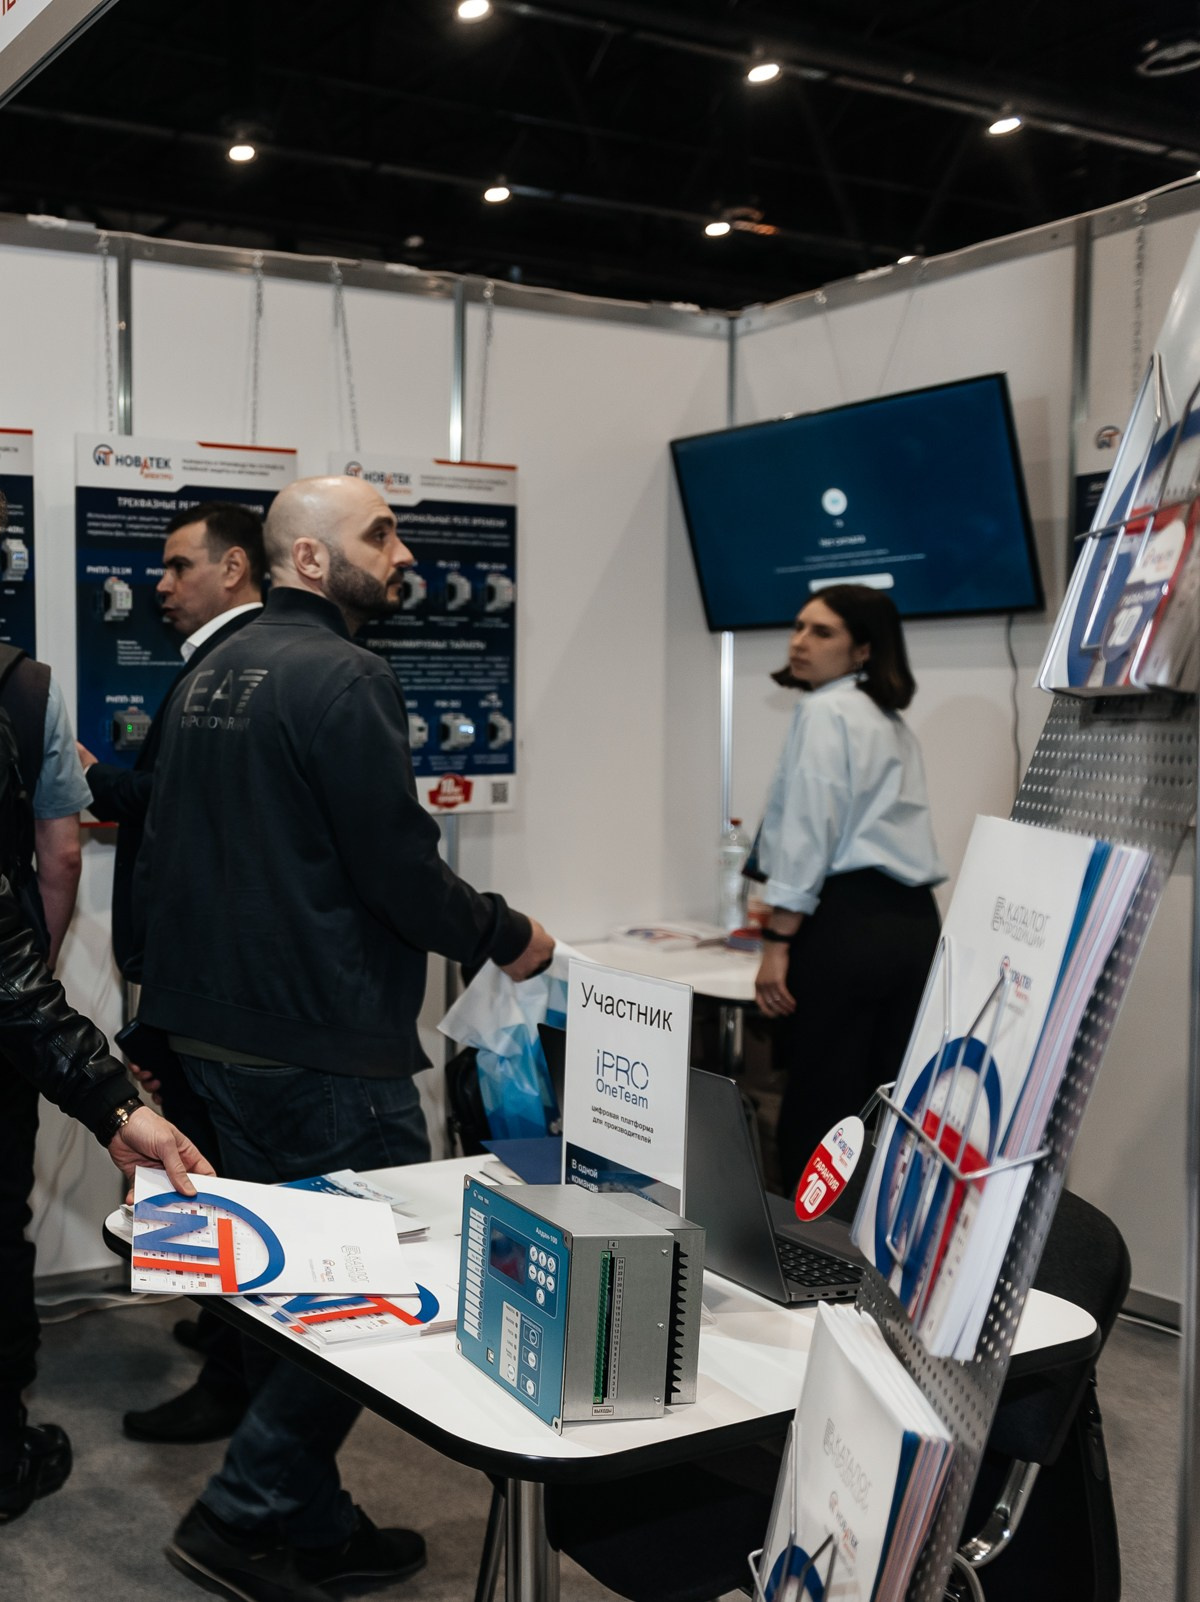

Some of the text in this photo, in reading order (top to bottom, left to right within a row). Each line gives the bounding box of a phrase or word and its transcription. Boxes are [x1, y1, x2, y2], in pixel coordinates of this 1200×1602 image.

[115, 455, 171, 475] НОВАТЕК
[183, 668, 269, 715] EA7
[1007, 902, 1052, 933] КАТАЛОГ
[581, 981, 673, 1032] Участник
[596, 1049, 650, 1090] iPRO
[595, 1078, 649, 1110] OneTeam
[591, 1104, 654, 1134] цифровая платформа
[592, 1116, 652, 1144] для производителей
[571, 1158, 598, 1179] В одной
[813, 1157, 840, 1192] ГАРАНТИЯ
[800, 1172, 827, 1214] 10
